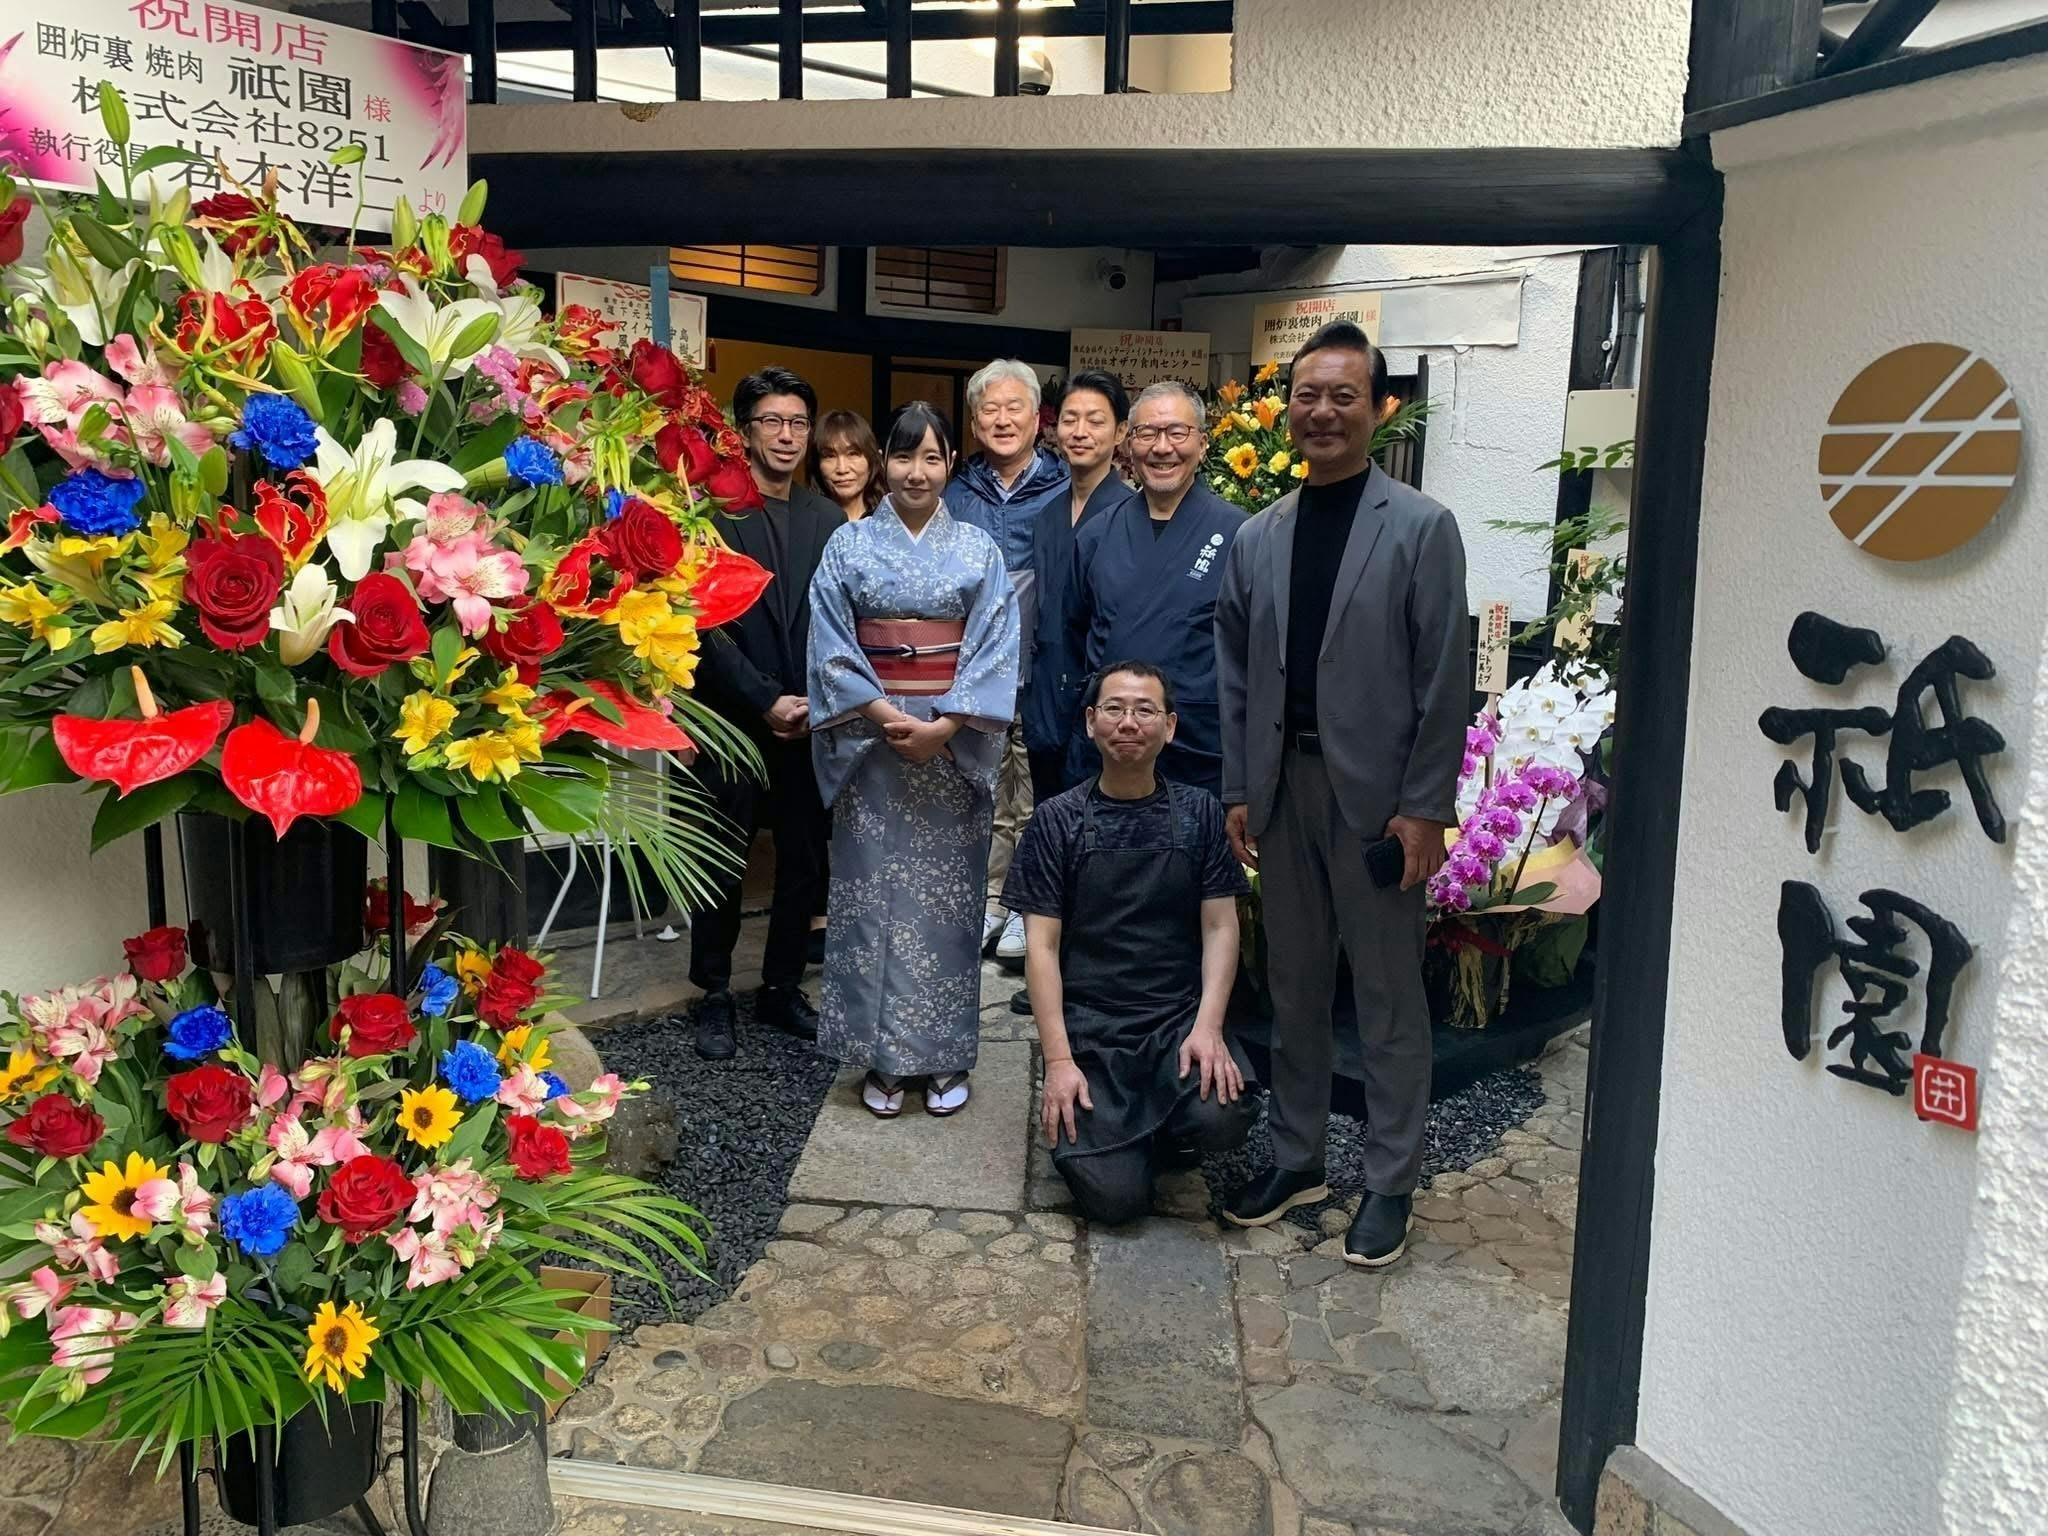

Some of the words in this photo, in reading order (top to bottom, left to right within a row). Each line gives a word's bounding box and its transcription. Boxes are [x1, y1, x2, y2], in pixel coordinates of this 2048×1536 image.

[128, 0, 328, 66] 祝開店
[36, 22, 134, 73] 囲炉裏
[145, 44, 204, 84] 焼肉
[363, 95, 392, 123] 様
[417, 188, 447, 213] より
[1295, 299, 1336, 314] 祝開店
